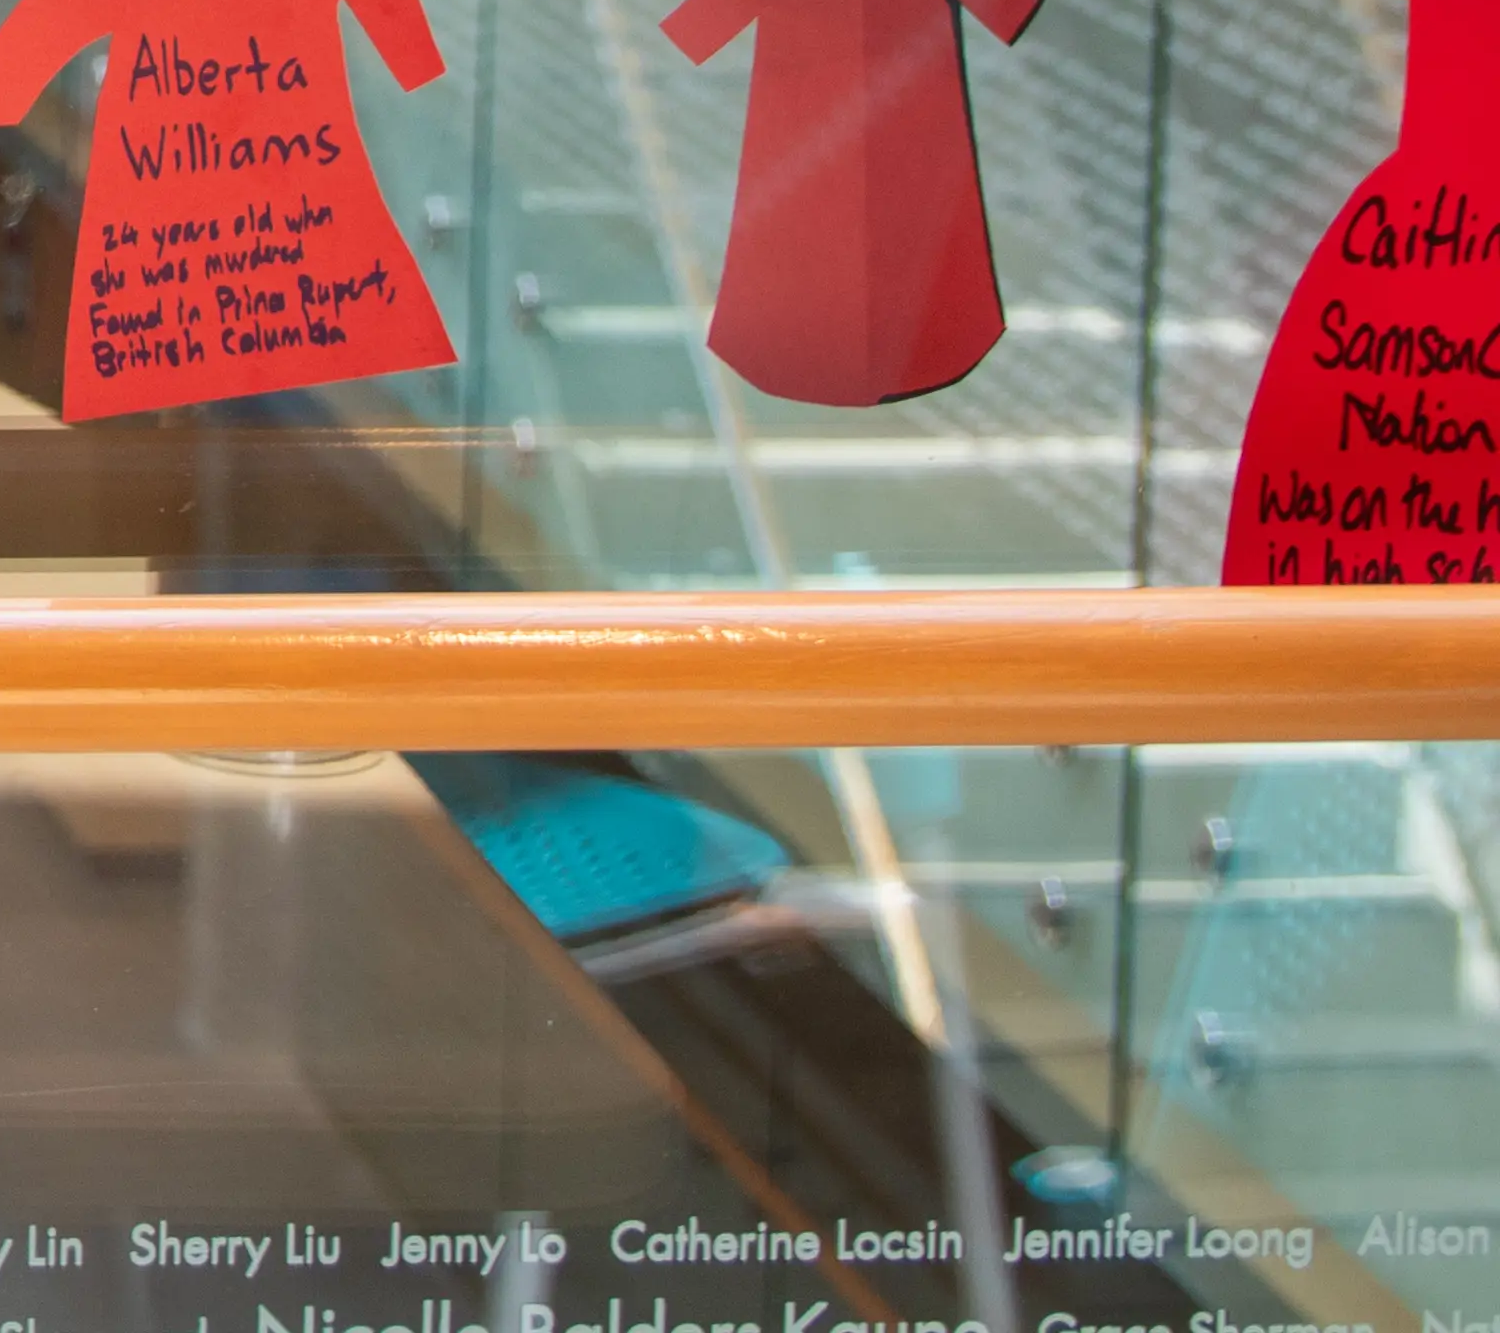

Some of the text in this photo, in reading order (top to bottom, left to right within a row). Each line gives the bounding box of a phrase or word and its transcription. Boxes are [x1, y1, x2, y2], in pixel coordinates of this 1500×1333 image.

[130, 34, 308, 102] Alberta
[121, 123, 341, 181] Williams
[102, 222, 138, 251] 24
[152, 219, 220, 260] years
[234, 201, 273, 237] old
[141, 257, 188, 287] was
[205, 236, 304, 279] murdered
[177, 296, 201, 326] in
[92, 328, 205, 379] British
[1338, 389, 1497, 455] Nation
[1402, 473, 1465, 534] the
[26, 1224, 85, 1269] Lin
[129, 1220, 272, 1278] Sherry
[286, 1223, 342, 1266] Liu
[380, 1221, 506, 1277] Jenny
[520, 1220, 567, 1265] Lo
[610, 1216, 821, 1264] Catherine
[836, 1218, 964, 1262] Locsin
[1003, 1212, 1173, 1263] Jennifer
[1186, 1216, 1315, 1270] Loong
[1356, 1211, 1490, 1258] Alison
